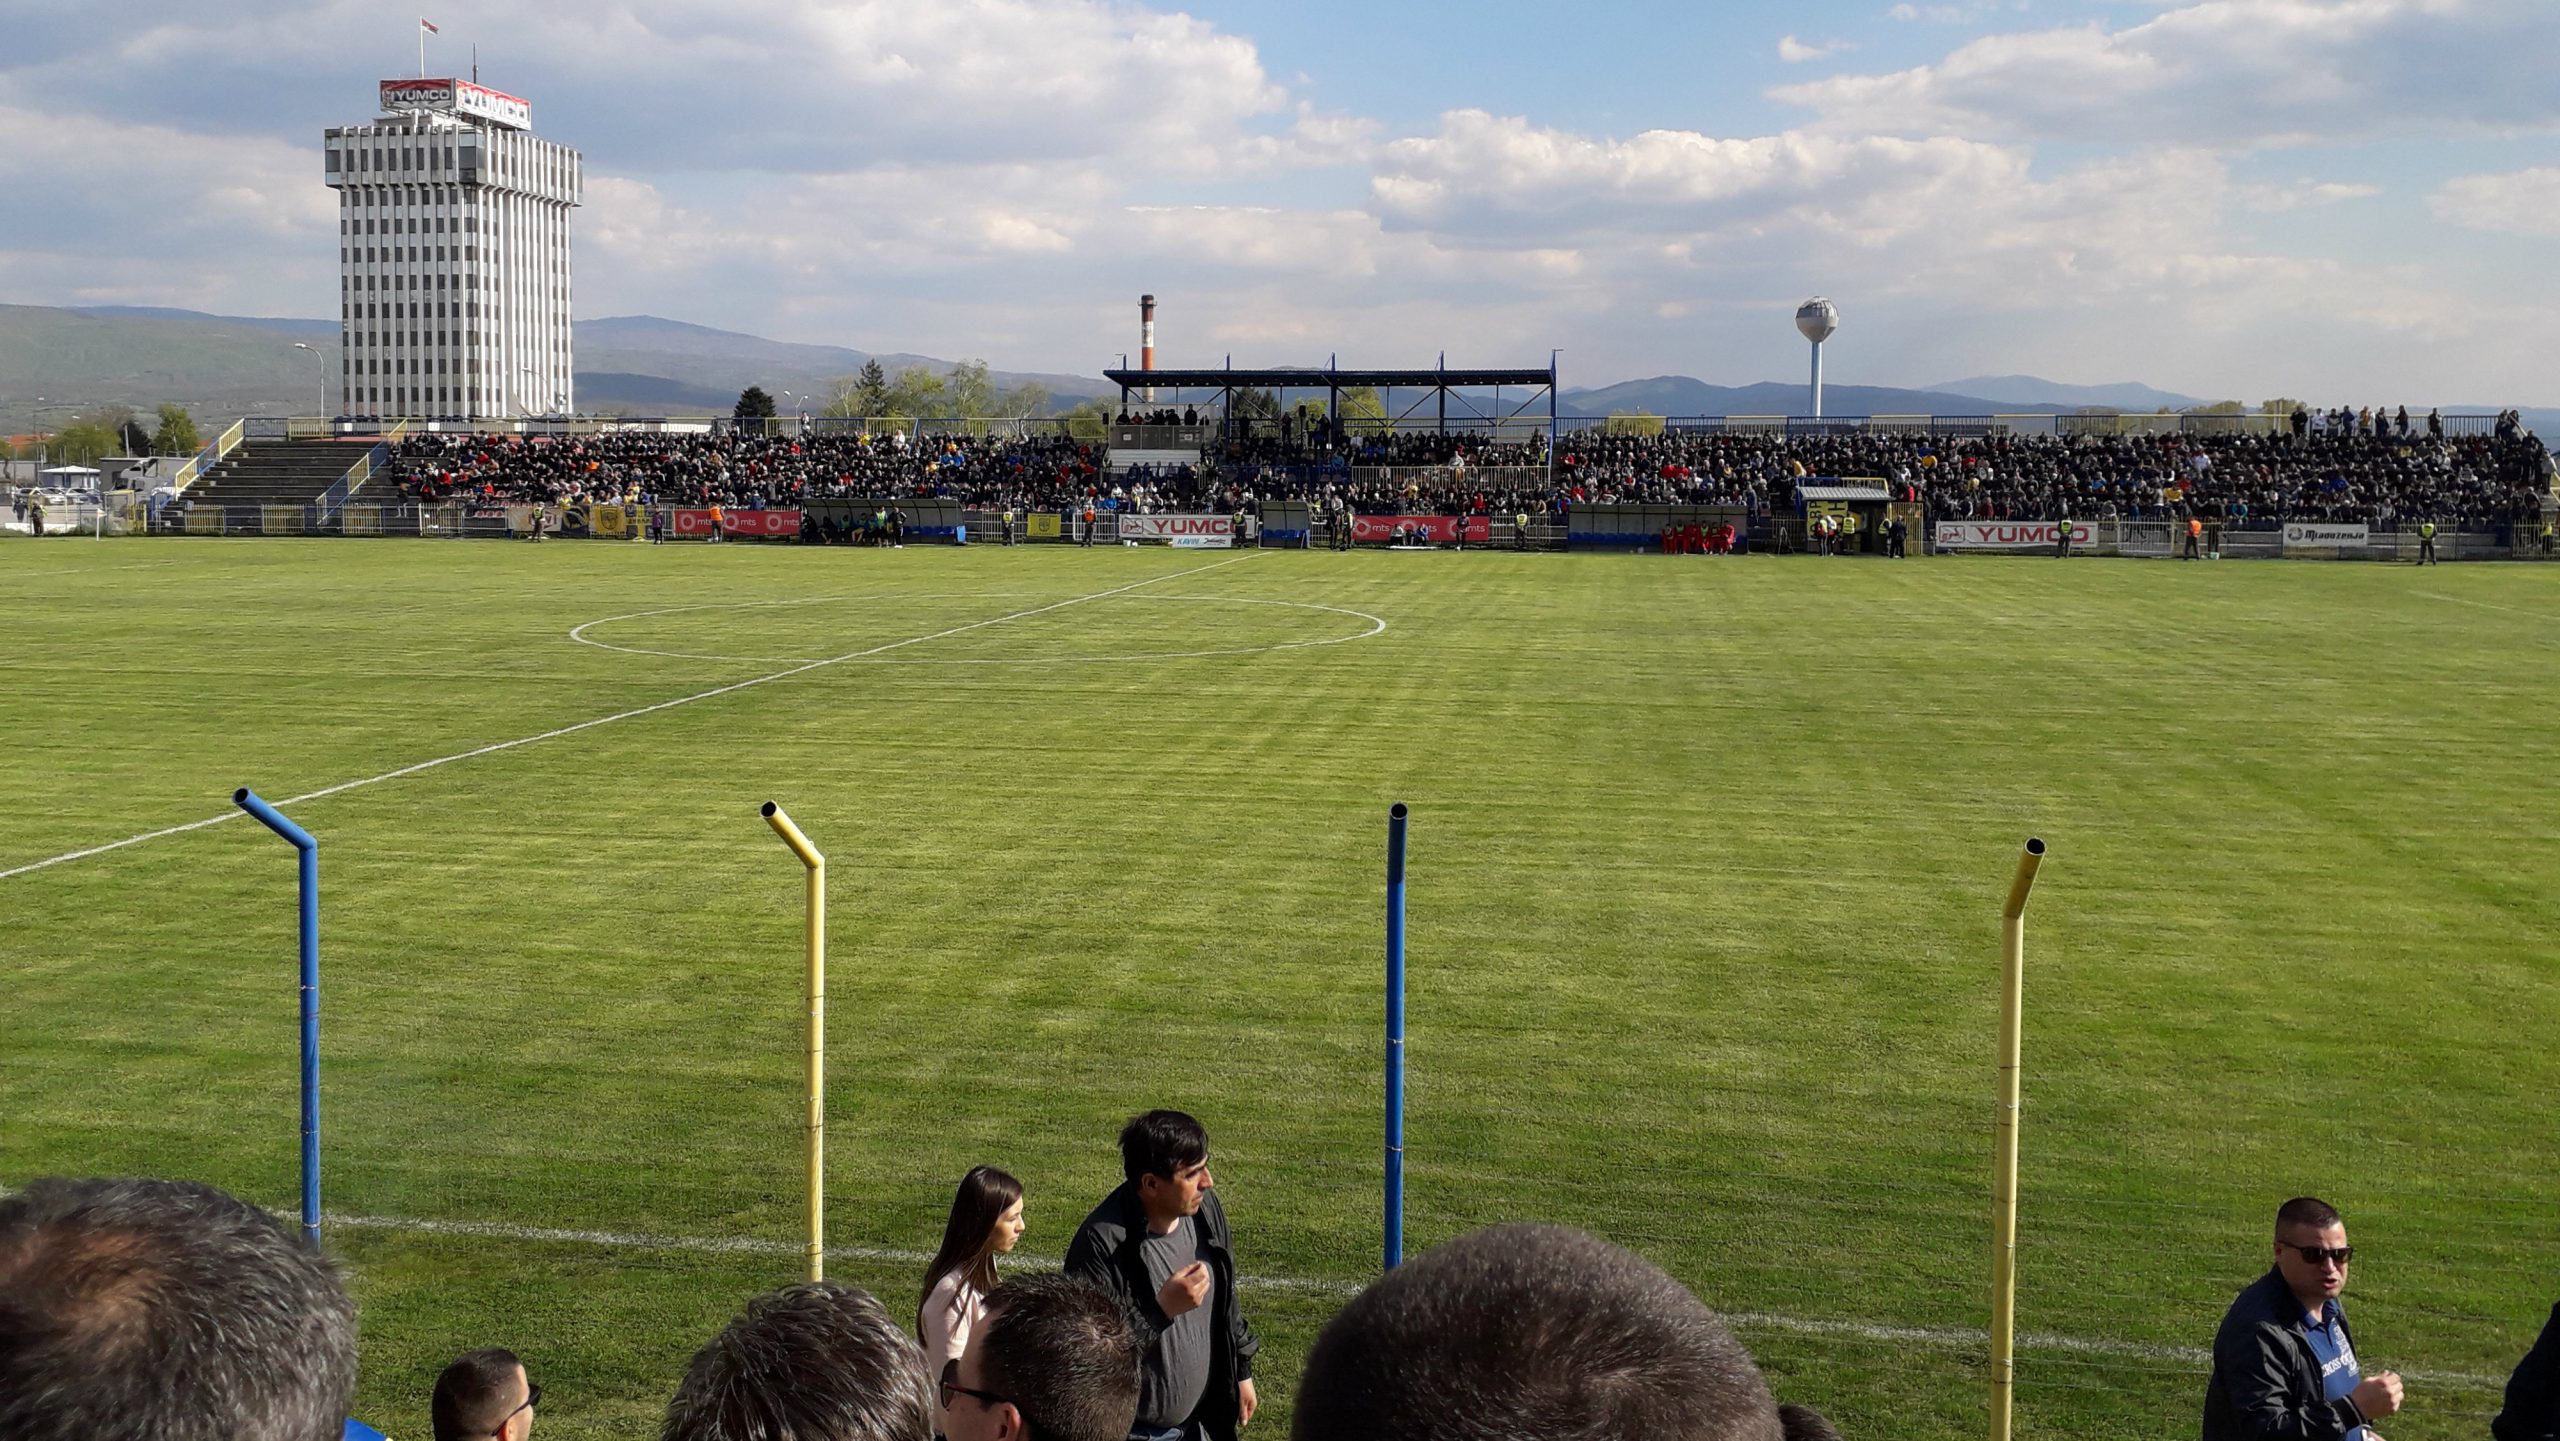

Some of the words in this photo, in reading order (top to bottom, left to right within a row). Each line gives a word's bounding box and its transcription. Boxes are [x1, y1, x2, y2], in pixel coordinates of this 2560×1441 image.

[396, 89, 450, 100] YUMCO
[465, 88, 528, 121] YUMCO
[1372, 524, 1390, 532] mts
